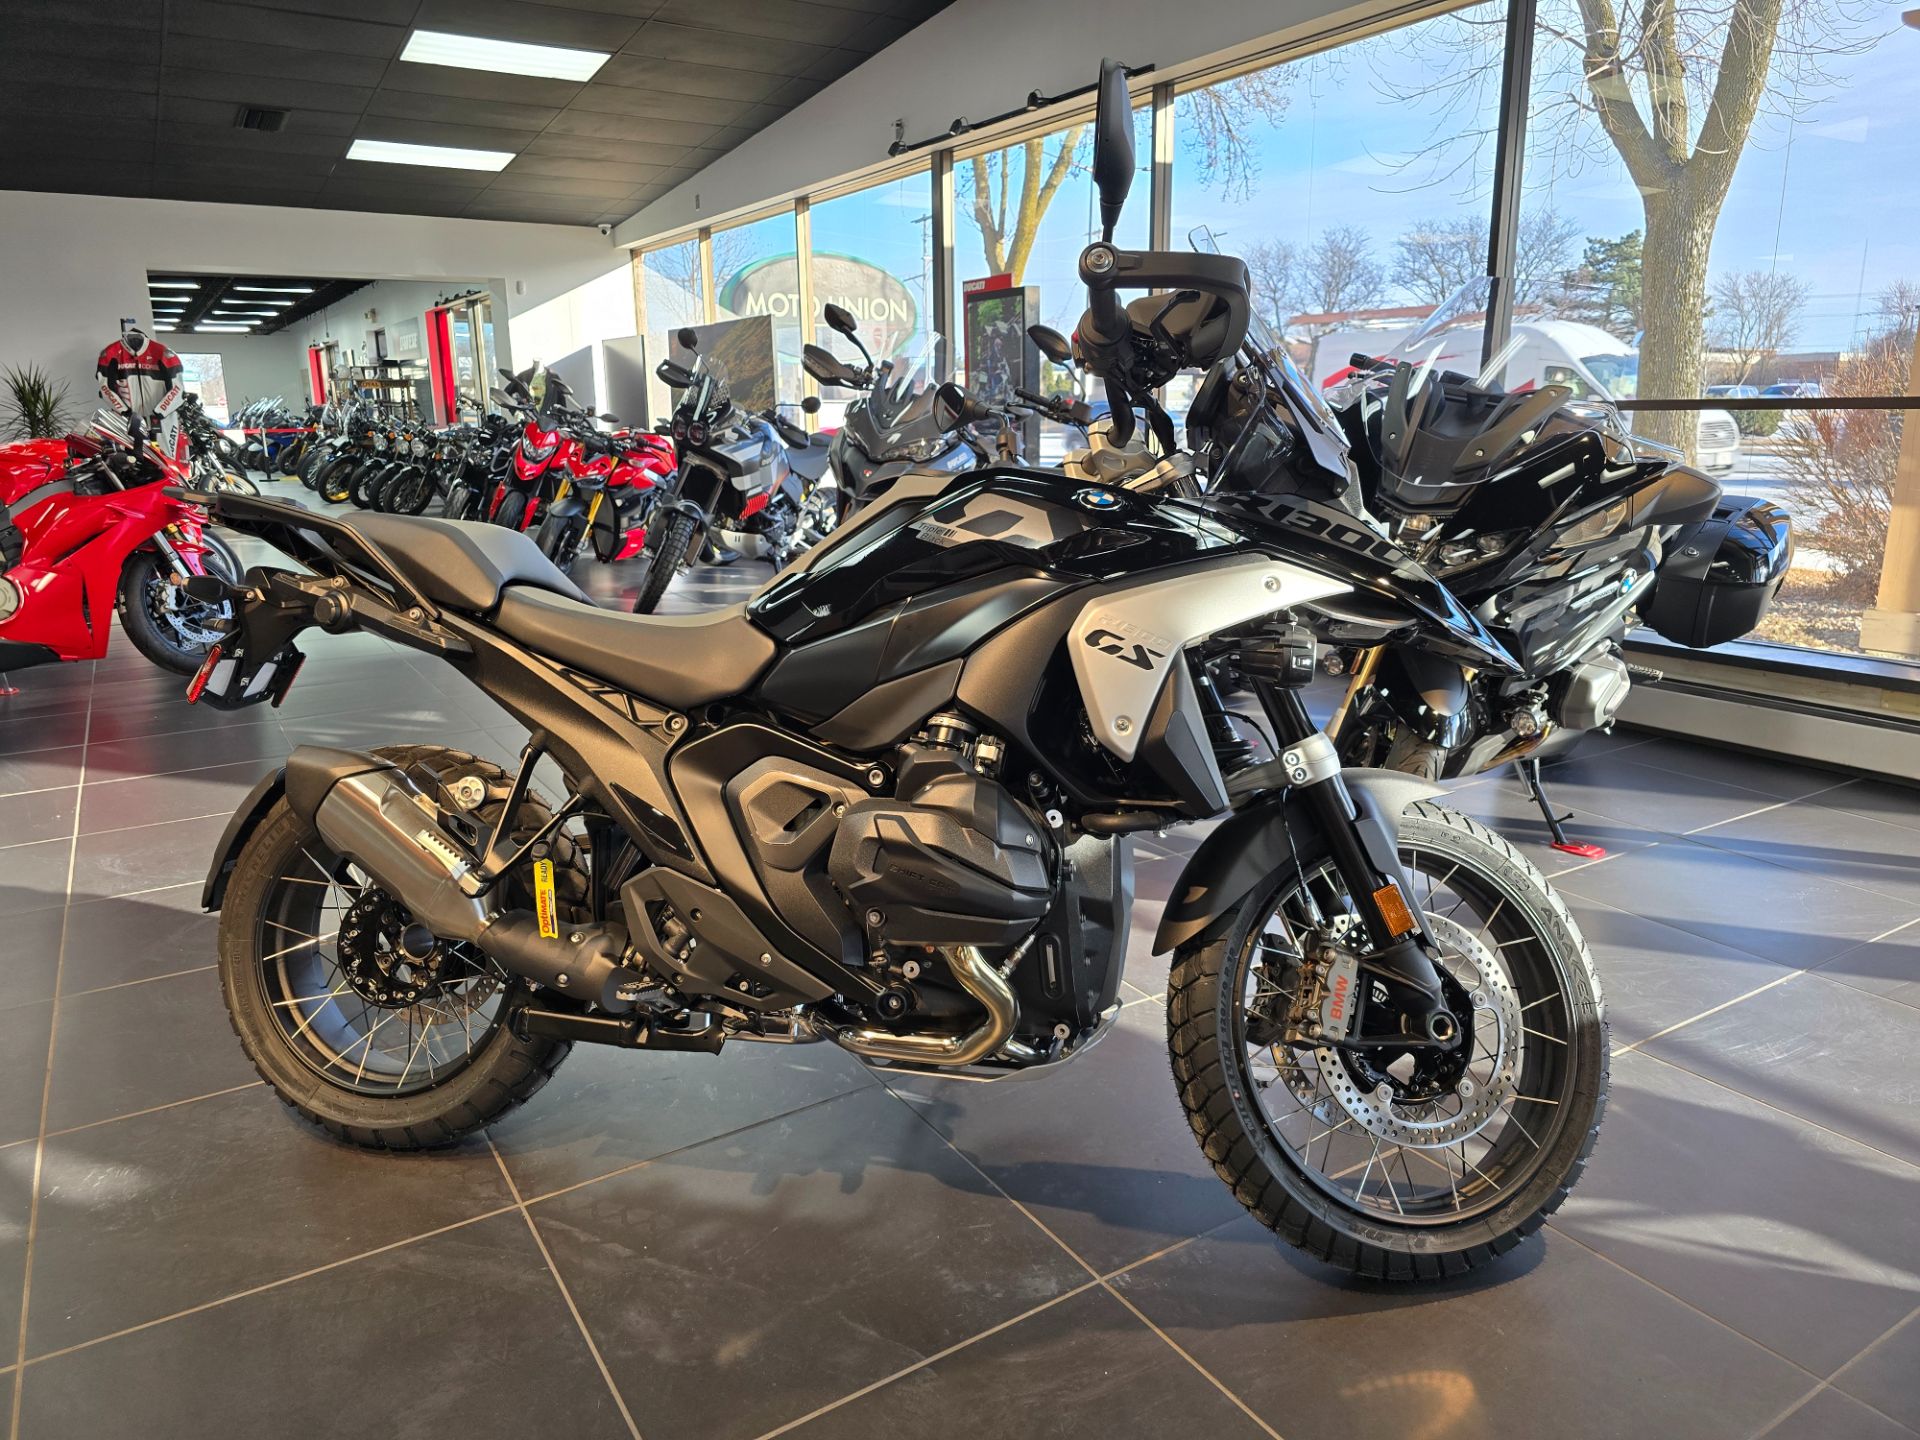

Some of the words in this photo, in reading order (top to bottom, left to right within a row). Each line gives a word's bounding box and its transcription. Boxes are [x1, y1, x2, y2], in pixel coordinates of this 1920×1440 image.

[101, 384, 123, 409] DUCATI
[160, 385, 180, 411] DUCATI
[918, 522, 943, 535] Triple
[1084, 628, 1167, 671] GS
[1540, 906, 1592, 1015] ANAKEE
[1329, 974, 1349, 1021] BMW
